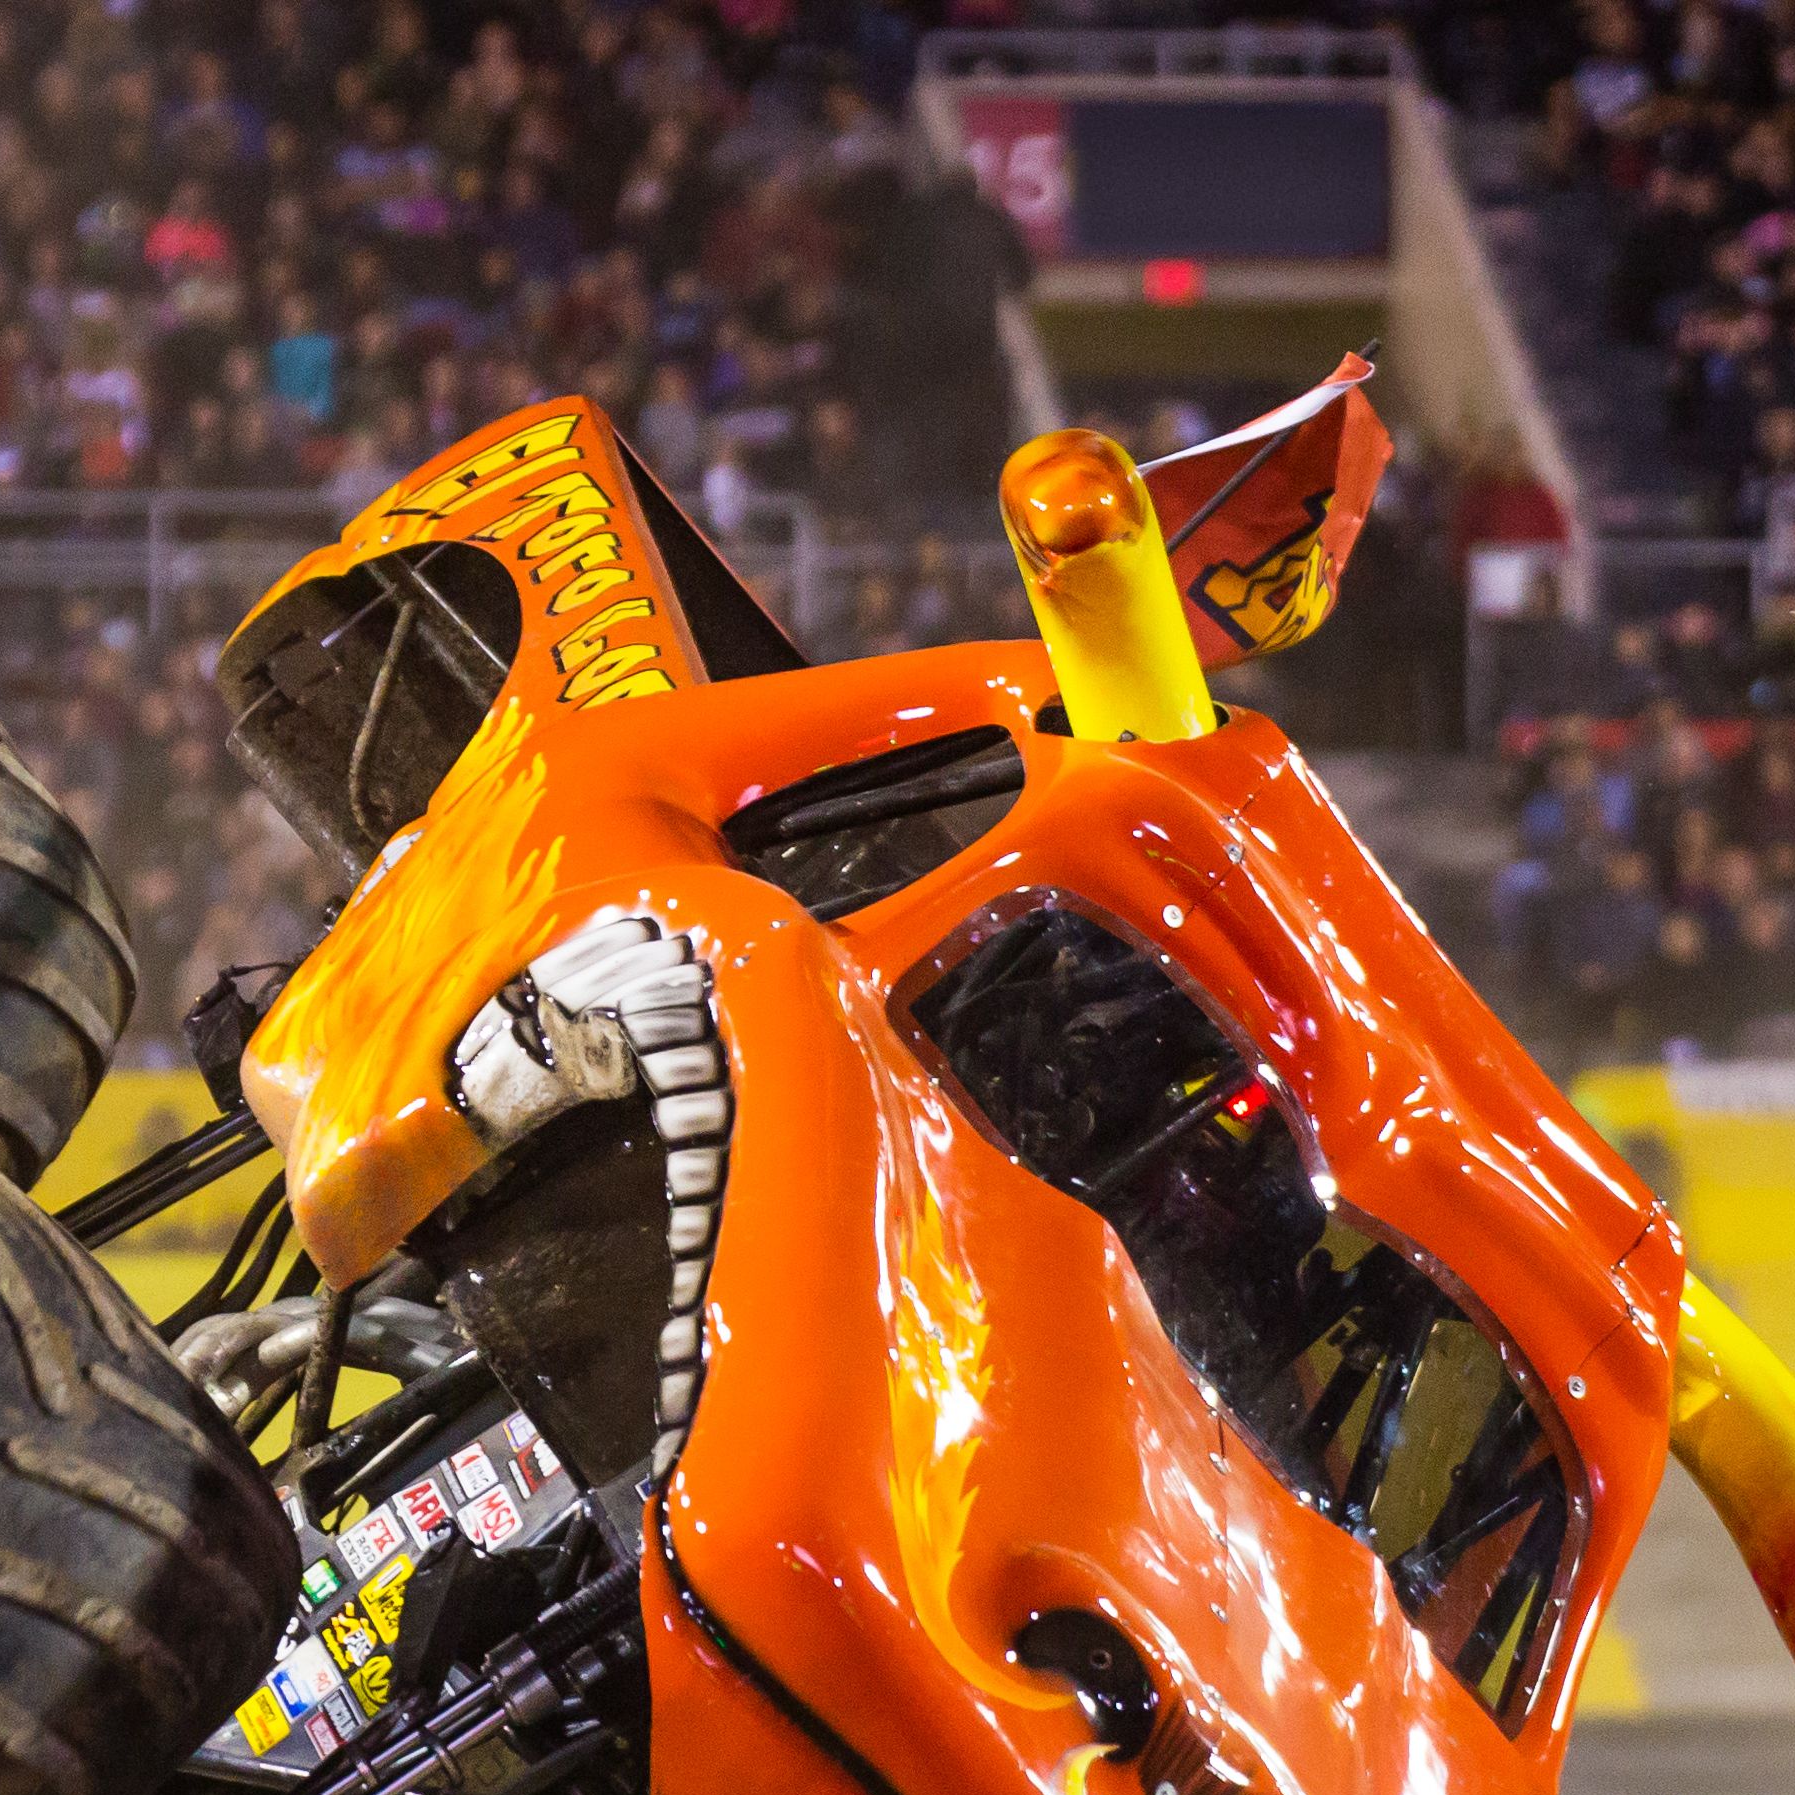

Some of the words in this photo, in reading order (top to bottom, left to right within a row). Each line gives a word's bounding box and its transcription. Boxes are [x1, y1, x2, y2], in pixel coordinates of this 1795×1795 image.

[473, 1489, 517, 1542] MSD
[356, 1534, 377, 1565] ROD
[363, 1516, 396, 1554] FK
[339, 1536, 367, 1575] ENDS
